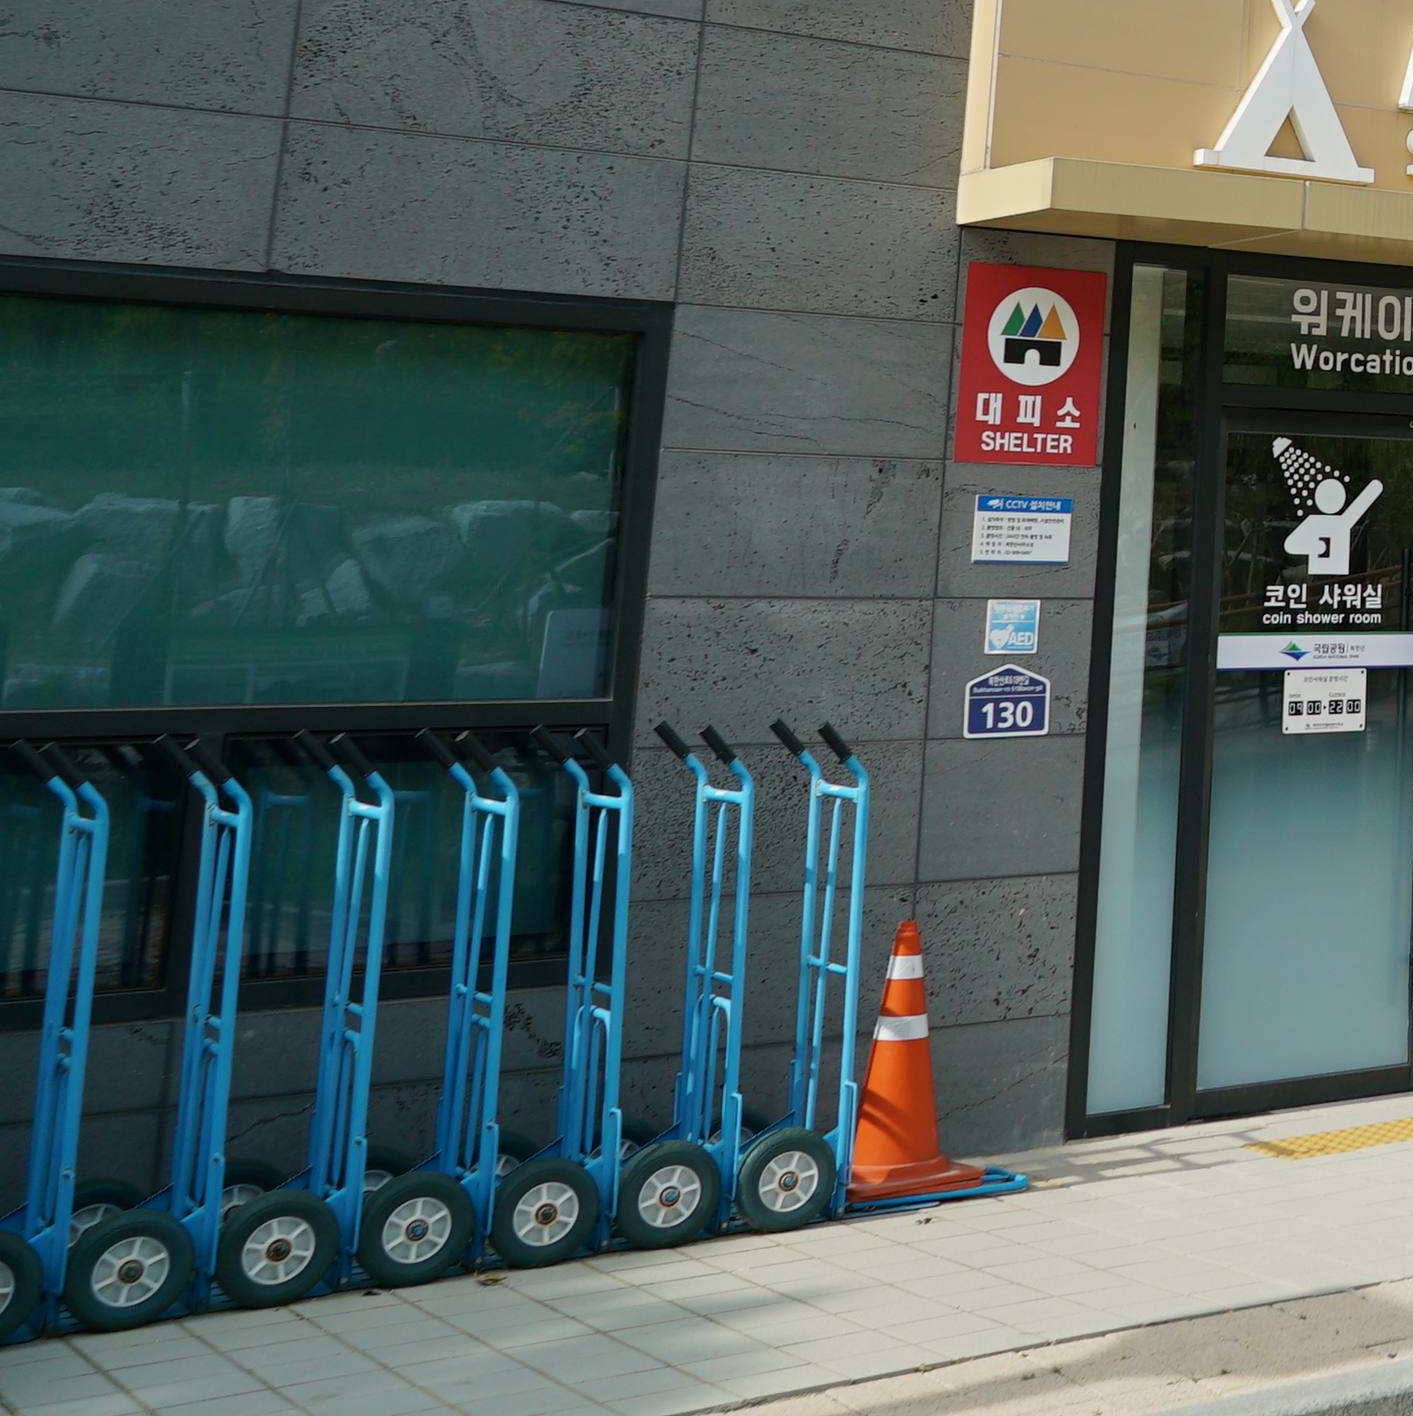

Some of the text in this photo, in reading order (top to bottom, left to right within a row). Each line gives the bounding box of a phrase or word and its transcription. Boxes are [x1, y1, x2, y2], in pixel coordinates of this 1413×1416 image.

[980, 431, 1074, 455] SHELTER
[1005, 499, 1029, 510] CCTV
[1263, 584, 1383, 610] 코인 샤워실
[1262, 611, 1382, 626] coin shower room
[1008, 631, 1034, 645] AED
[1313, 642, 1346, 654] 국립공원
[1329, 701, 1343, 713] 22
[1347, 700, 1361, 713] 00
[981, 700, 1034, 729] 130
